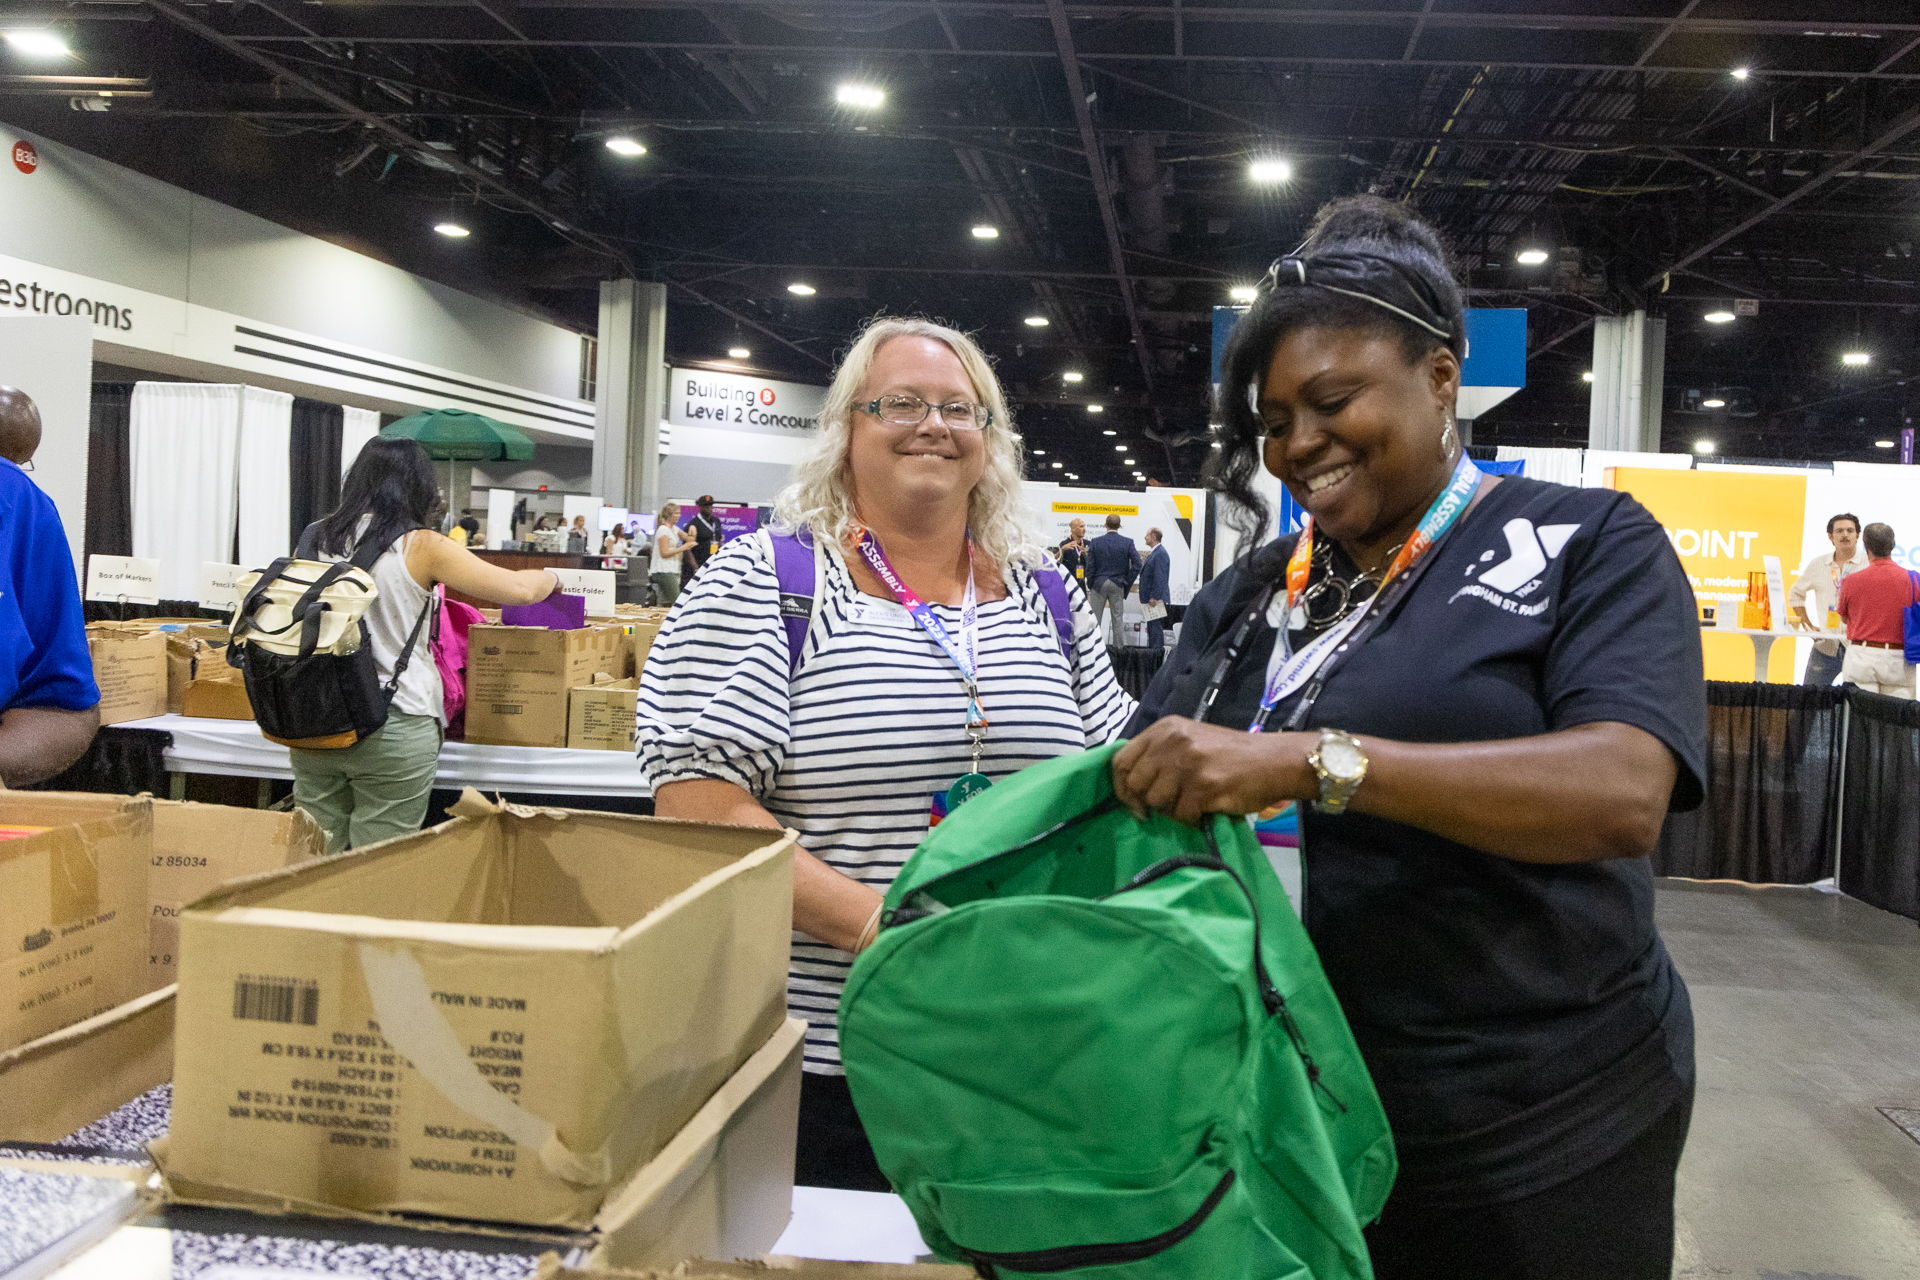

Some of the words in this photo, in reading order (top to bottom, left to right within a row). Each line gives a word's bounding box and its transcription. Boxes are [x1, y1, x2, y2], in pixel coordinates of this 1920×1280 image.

[686, 379, 755, 406] Building
[762, 391, 773, 403] B
[685, 401, 729, 422] Level
[734, 407, 743, 423] 2
[1411, 491, 1461, 558] ASSEMBLY
[859, 541, 907, 594] ASSEMBLY
[115, 572, 123, 580] of
[125, 574, 152, 582] Markers
[212, 580, 231, 588] Pencil
[1704, 576, 1749, 588] modern
[582, 587, 605, 595] Folder
[1514, 579, 1544, 599] YMCA
[1502, 598, 1519, 614] ST.
[917, 611, 945, 639] 2023
[166, 855, 207, 868] 85034
[467, 994, 483, 1008] IN
[487, 995, 527, 1011] MADE
[262, 1042, 284, 1057] CM
[315, 1047, 325, 1061] X
[356, 1050, 365, 1064] X
[468, 1045, 523, 1061] WEIGHT
[337, 1065, 376, 1081] EACH
[236, 1090, 252, 1104] IN
[287, 1094, 296, 1108] X
[298, 1096, 314, 1110] IN
[254, 1108, 294, 1123] BOOK
[297, 1113, 392, 1134] COMPOSITION
[483, 1147, 516, 1162] ITEM
[410, 1157, 493, 1177] HOMEWORK
